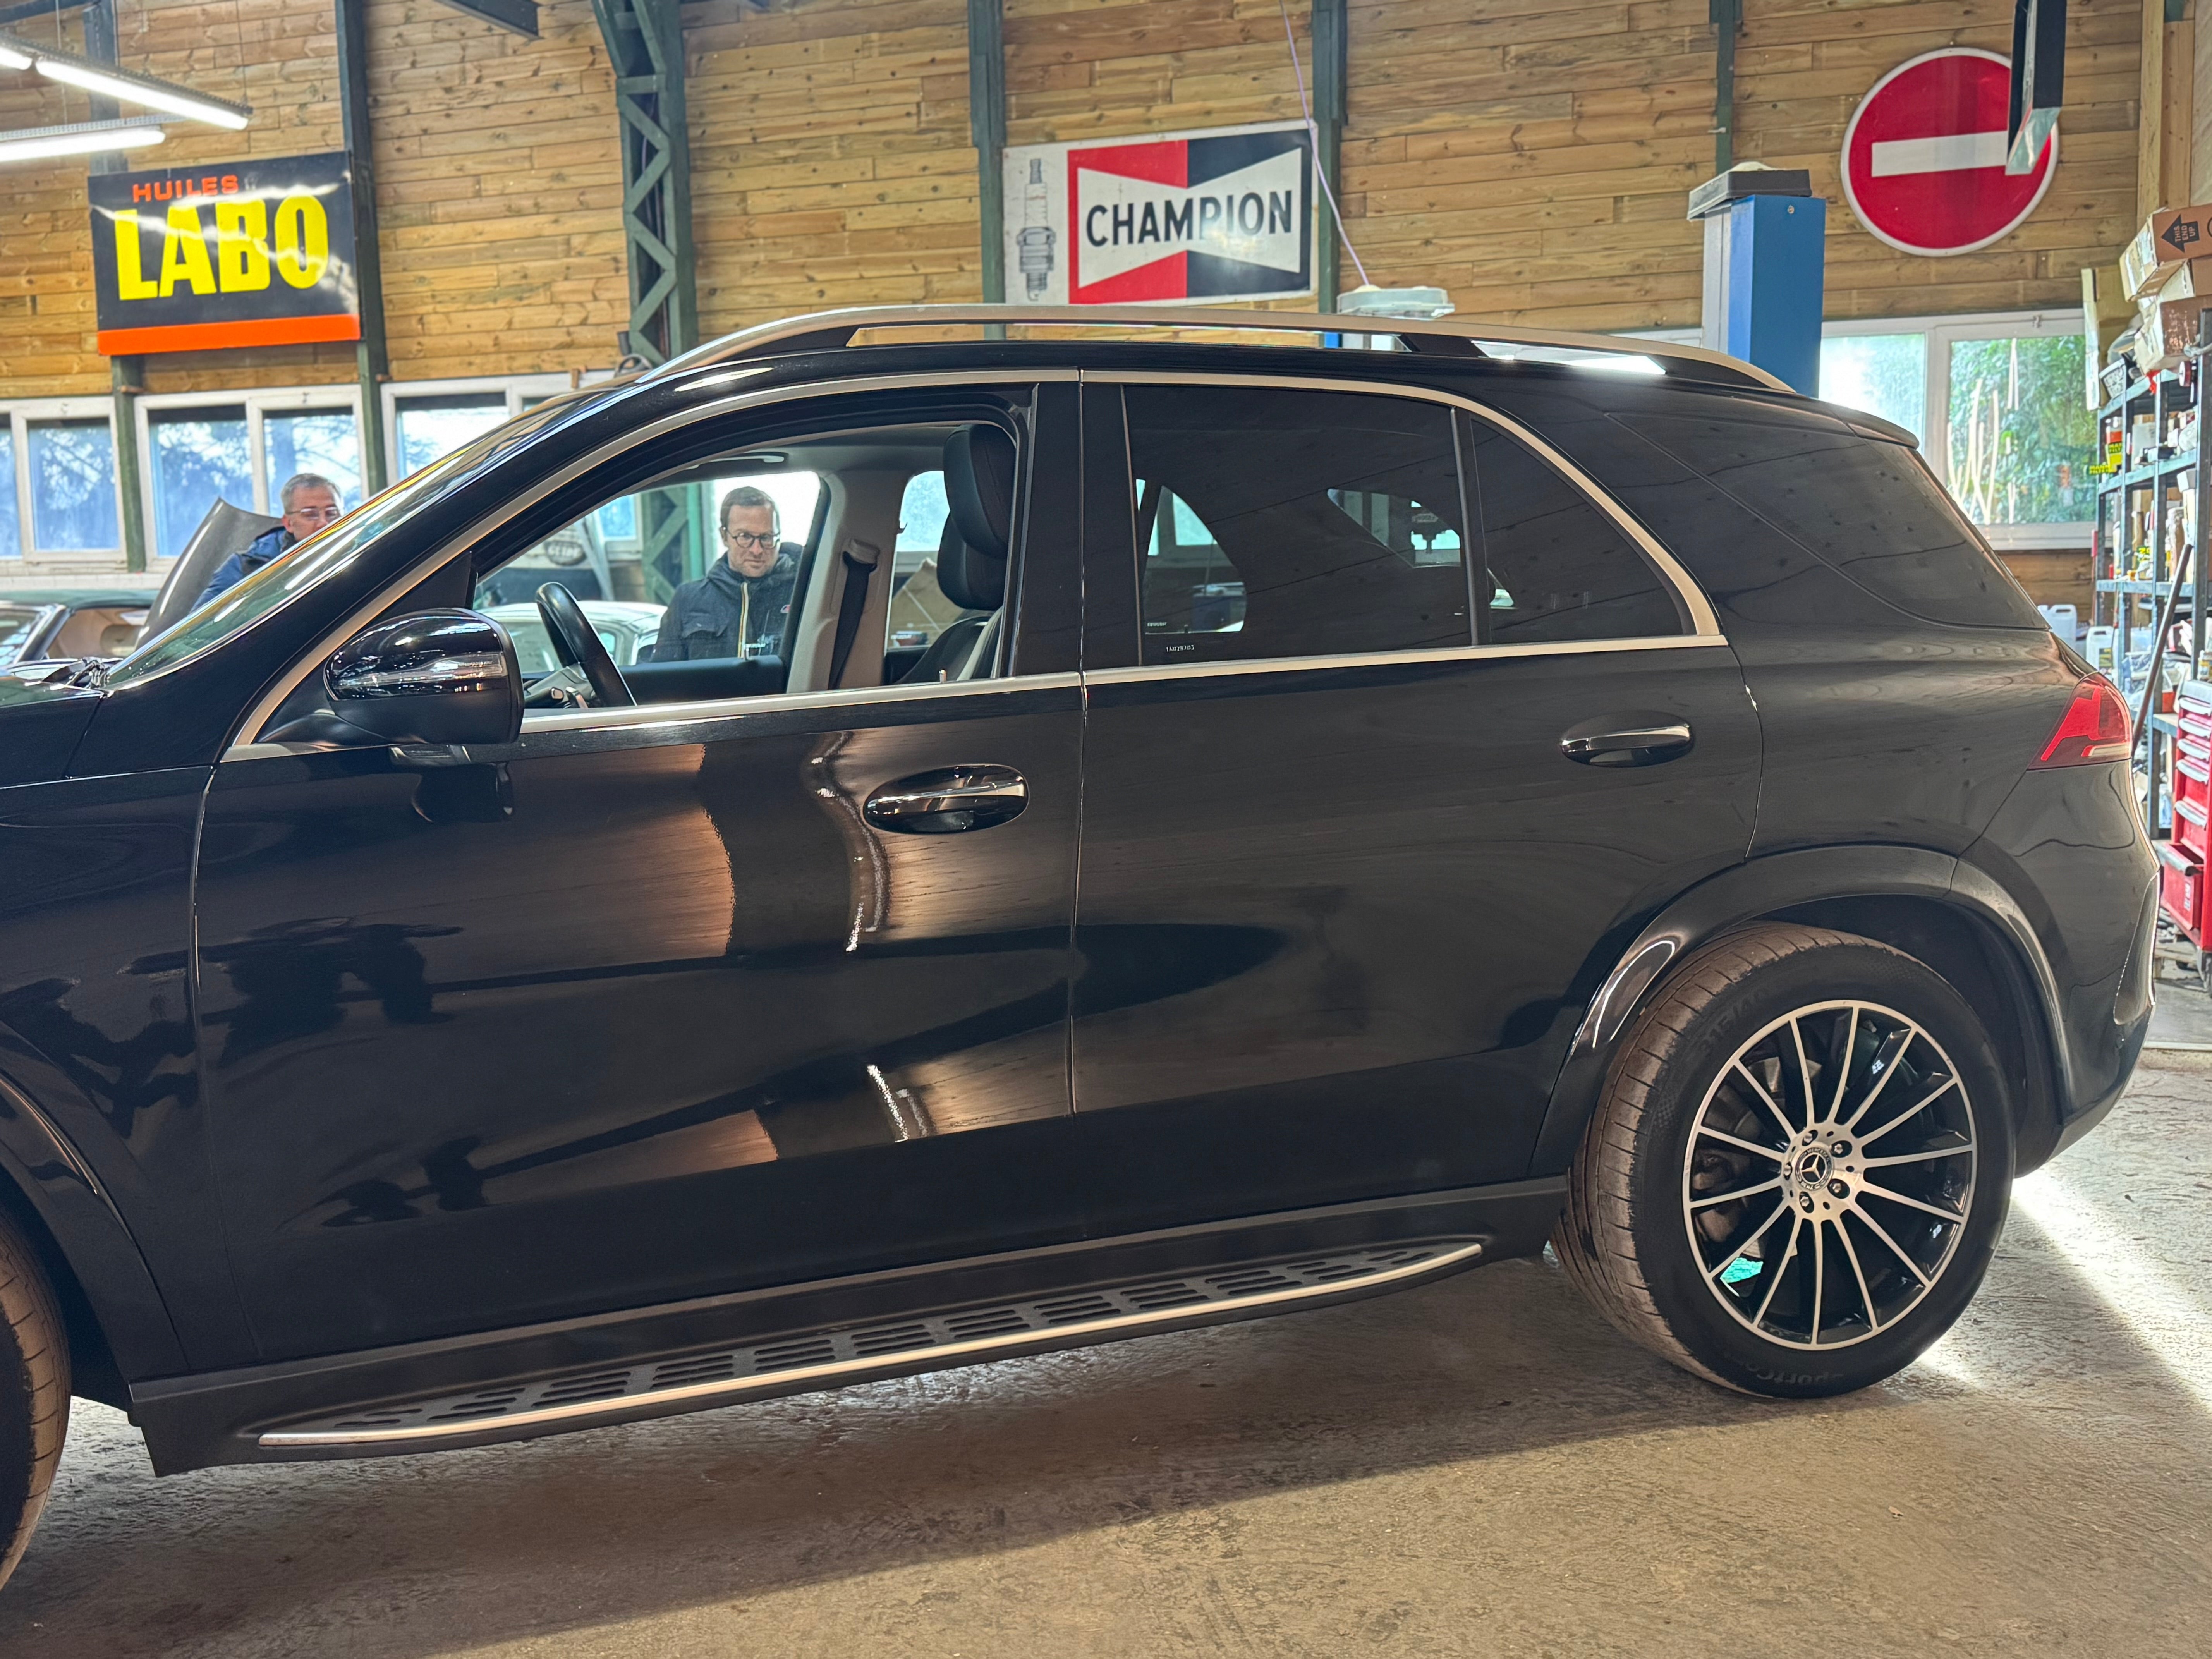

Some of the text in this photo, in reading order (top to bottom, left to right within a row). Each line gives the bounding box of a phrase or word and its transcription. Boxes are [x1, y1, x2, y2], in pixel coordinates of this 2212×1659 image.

[132, 175, 239, 203] HUILES
[1086, 190, 1292, 247] CHAMPION
[2189, 227, 2195, 237] UP
[115, 194, 328, 300] LABO
